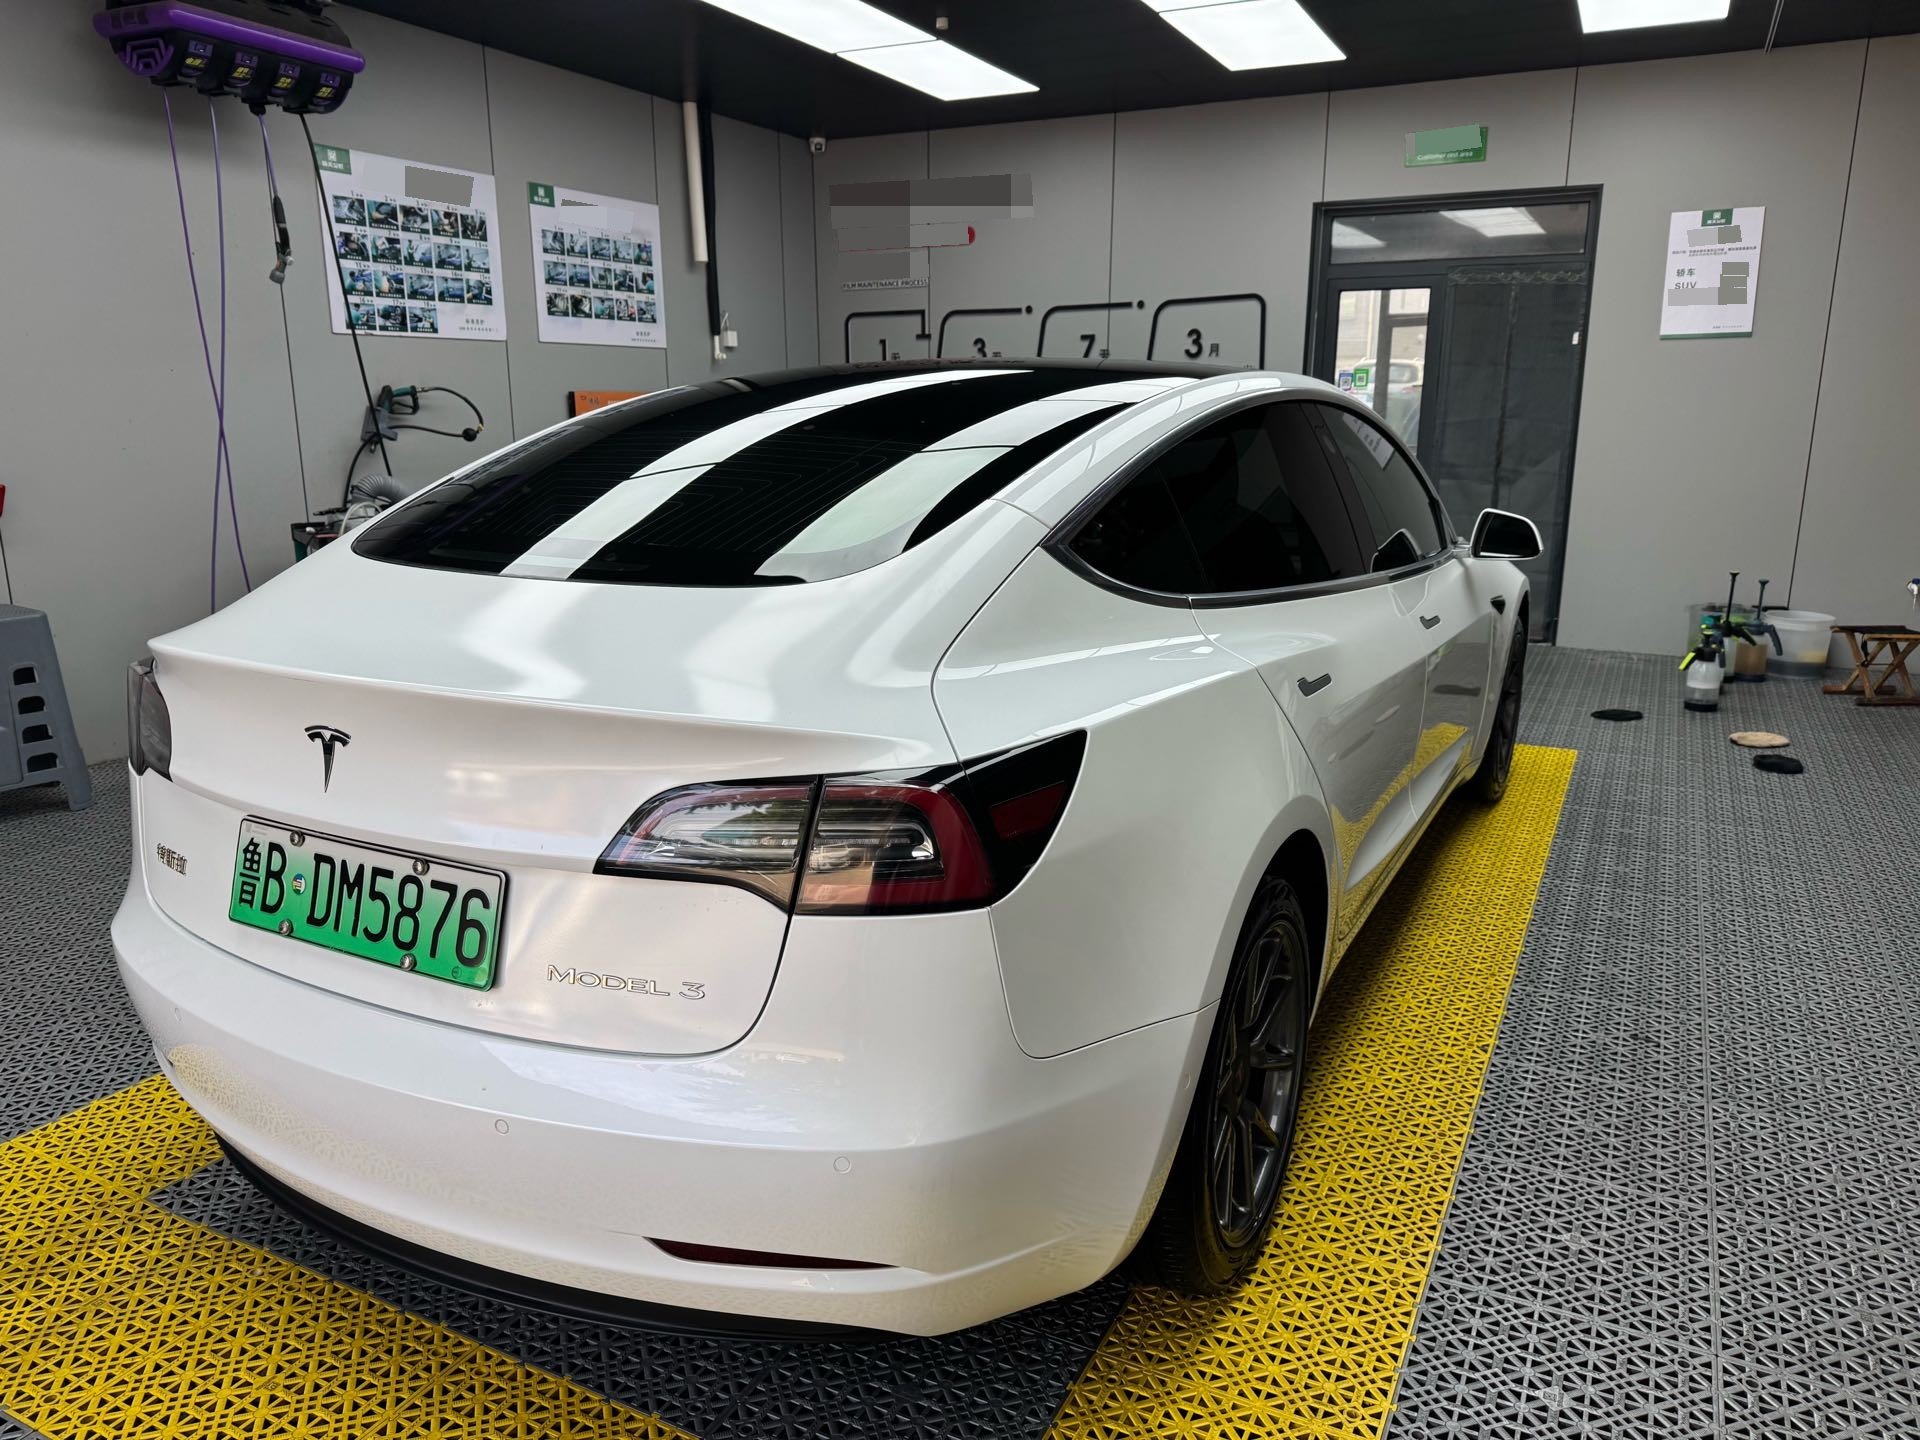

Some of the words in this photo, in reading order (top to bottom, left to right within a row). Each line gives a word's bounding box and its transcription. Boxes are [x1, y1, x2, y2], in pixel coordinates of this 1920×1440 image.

[857, 280, 900, 289] MAINTENANCE
[900, 279, 928, 287] PROCESS
[1674, 281, 1697, 290] SUV
[156, 843, 188, 875] 特斯拉
[679, 981, 706, 1000] 3
